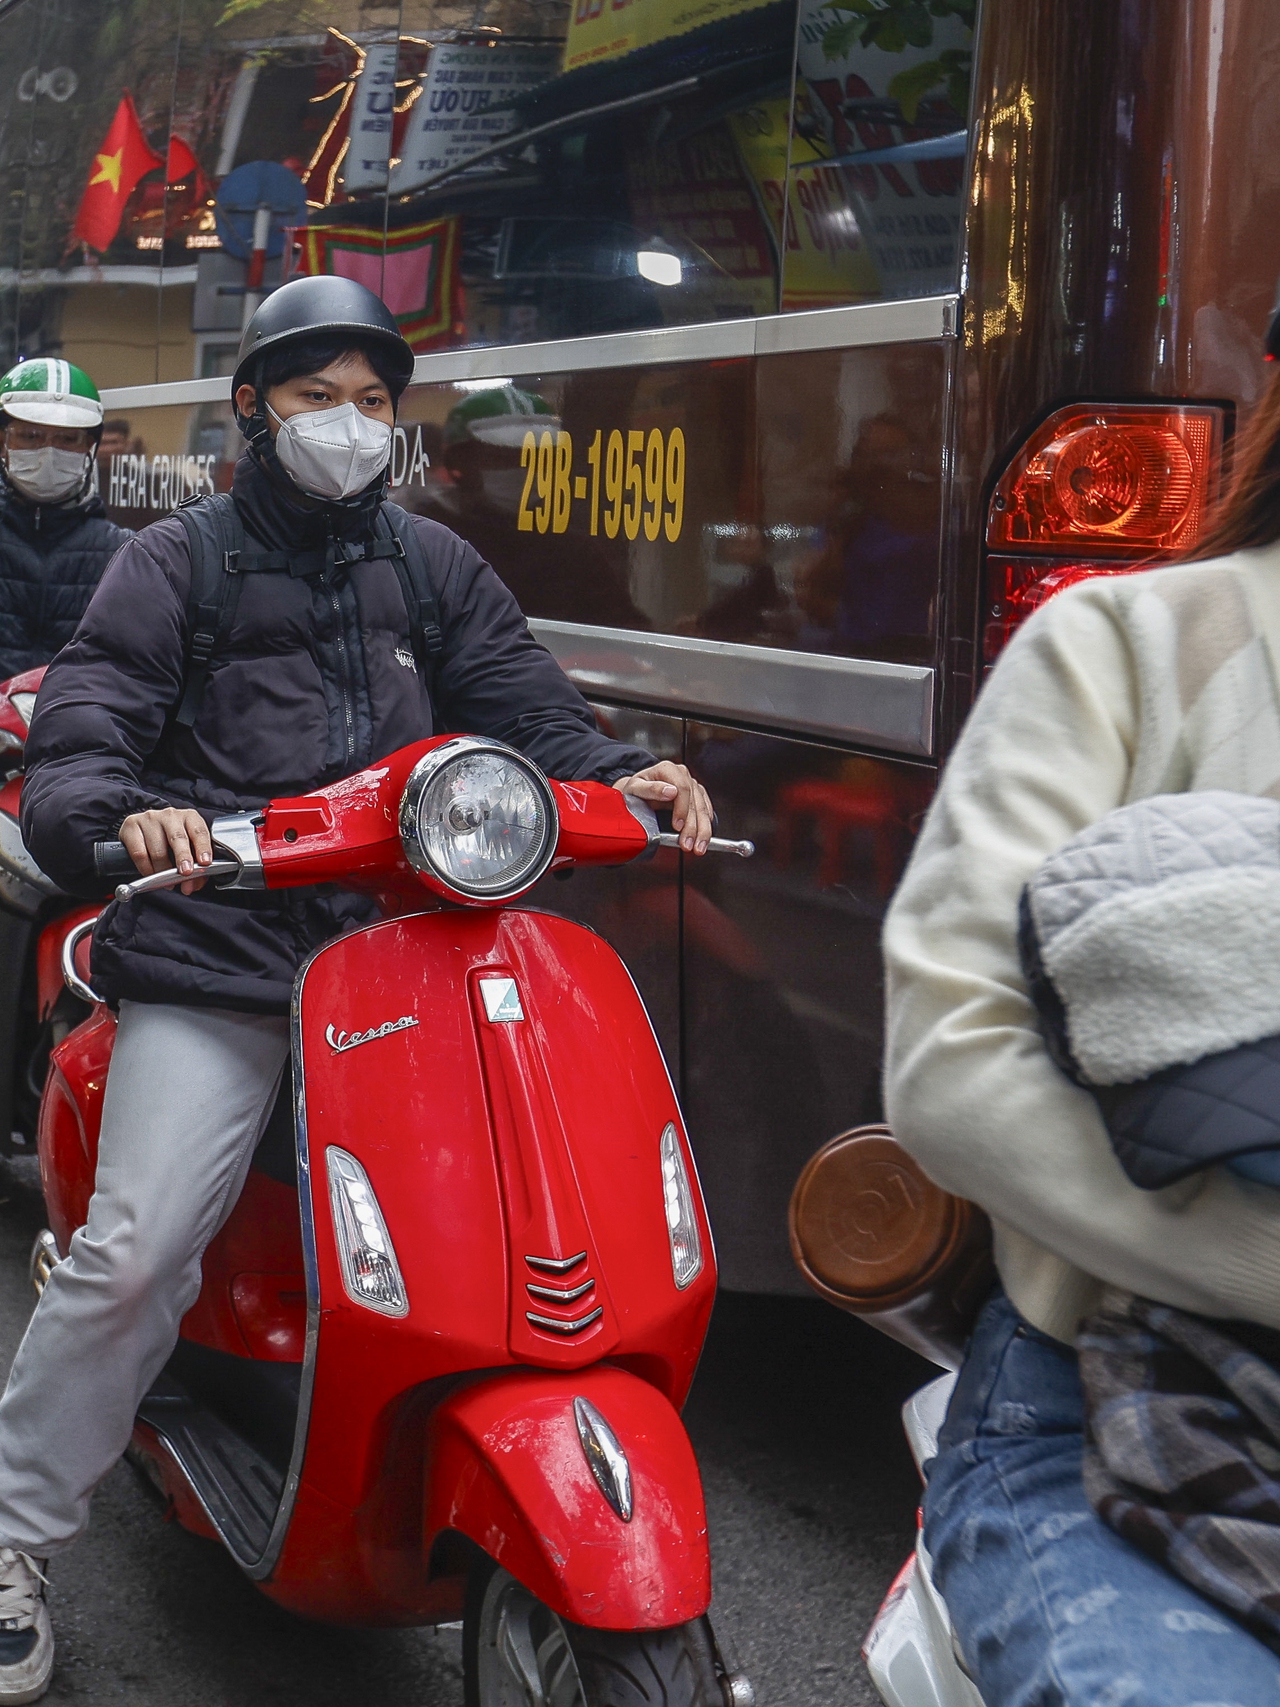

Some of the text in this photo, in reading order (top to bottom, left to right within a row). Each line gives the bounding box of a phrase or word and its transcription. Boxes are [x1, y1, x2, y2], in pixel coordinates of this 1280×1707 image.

[109, 454, 147, 509] HERA
[151, 454, 217, 510] CRUISES
[391, 424, 431, 488] DA
[518, 427, 685, 543] 29B-19599
[325, 1015, 420, 1054] Vespa
